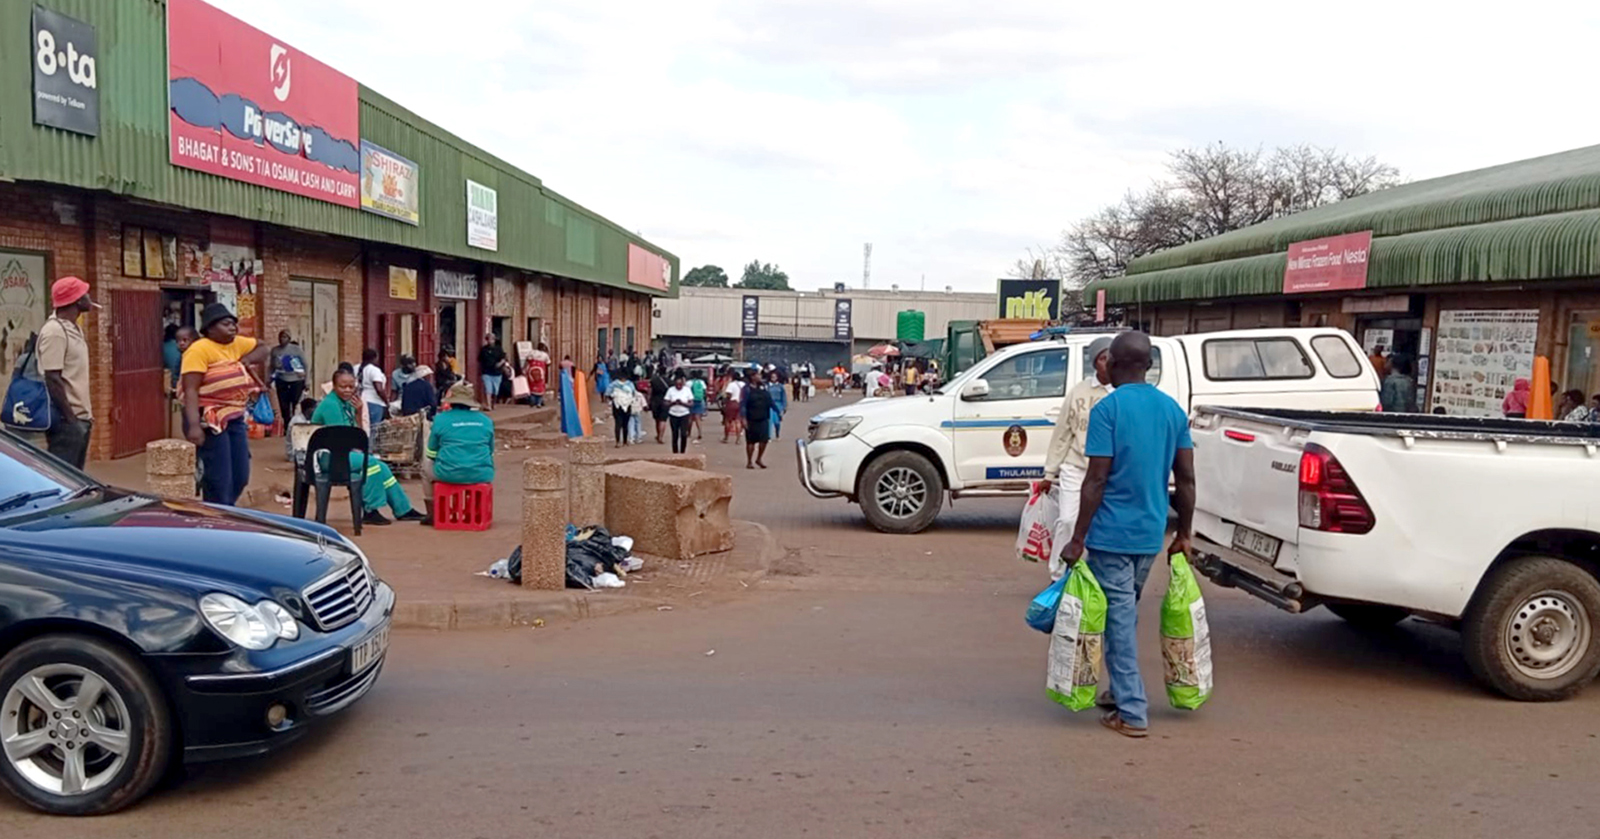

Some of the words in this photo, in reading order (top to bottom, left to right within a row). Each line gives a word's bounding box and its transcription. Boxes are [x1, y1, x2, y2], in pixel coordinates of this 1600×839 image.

[37, 91, 60, 103] powered
[60, 97, 67, 106] by
[67, 97, 85, 109] Telkom
[178, 136, 219, 164] BHAGAT
[221, 148, 229, 166] &
[230, 153, 254, 173] SONS
[255, 158, 270, 177] T/A
[272, 163, 299, 185] OSAMA
[300, 171, 319, 189] CASH
[321, 177, 335, 194] AND
[336, 182, 356, 199] CARRY
[1005, 288, 1052, 319] ntk
